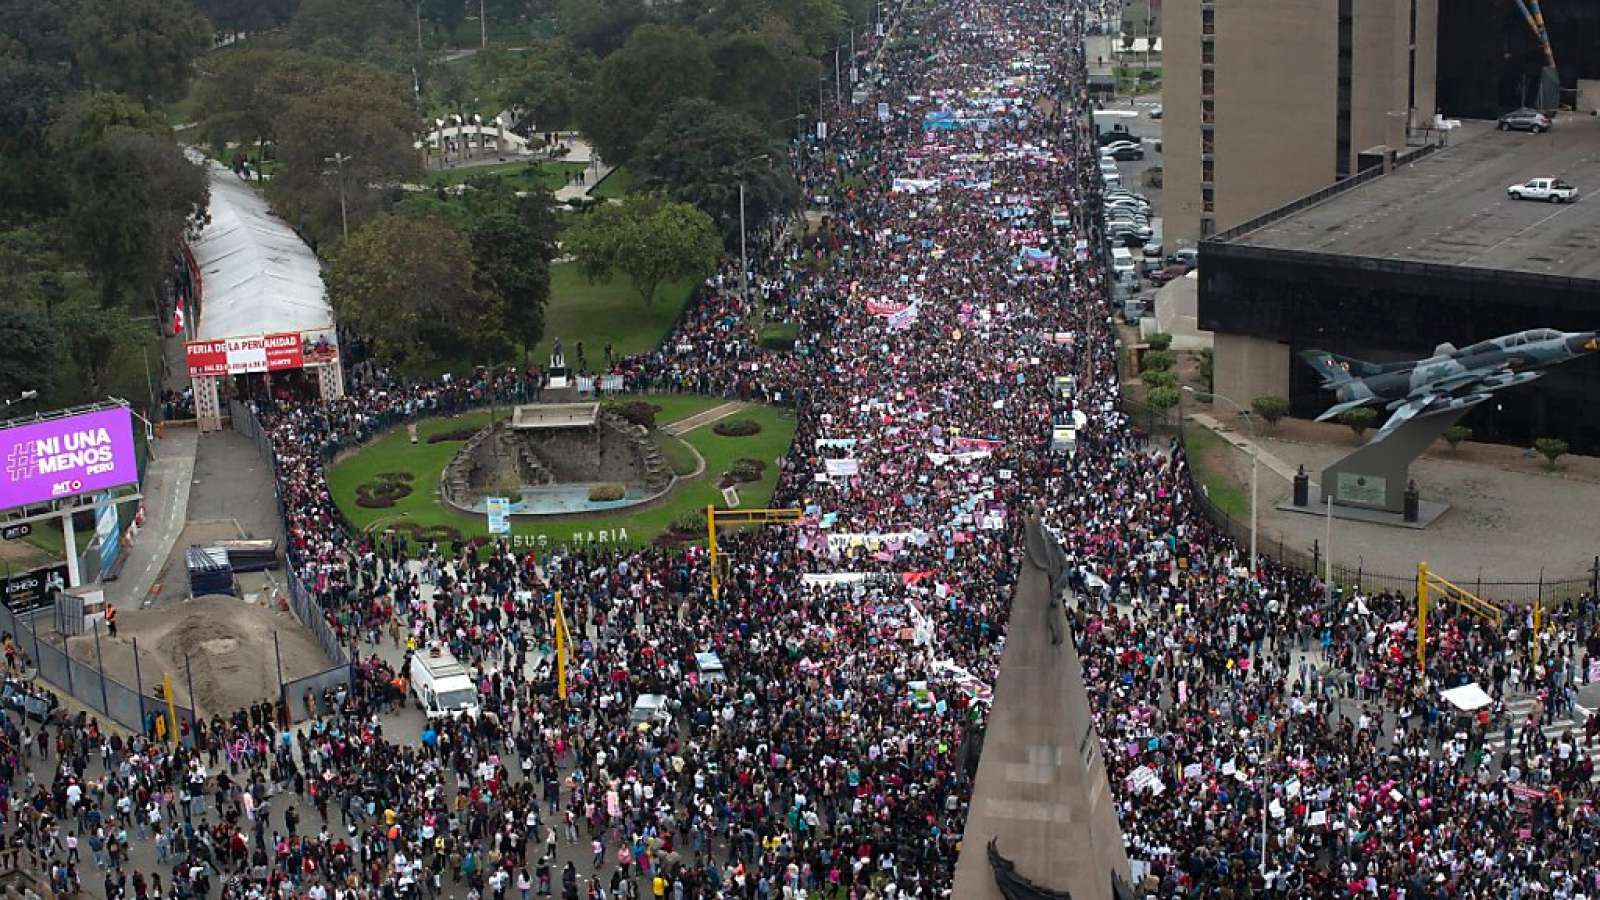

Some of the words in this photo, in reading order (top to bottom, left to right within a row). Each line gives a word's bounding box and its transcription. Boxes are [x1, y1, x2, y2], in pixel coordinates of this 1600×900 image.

[187, 343, 213, 355] FERIA
[215, 342, 228, 354] DE
[228, 341, 240, 351] LA
[241, 336, 296, 351] PERUANIDAD
[63, 427, 112, 451] UNA
[38, 445, 113, 475] MENOS
[573, 527, 628, 545] MARIA
